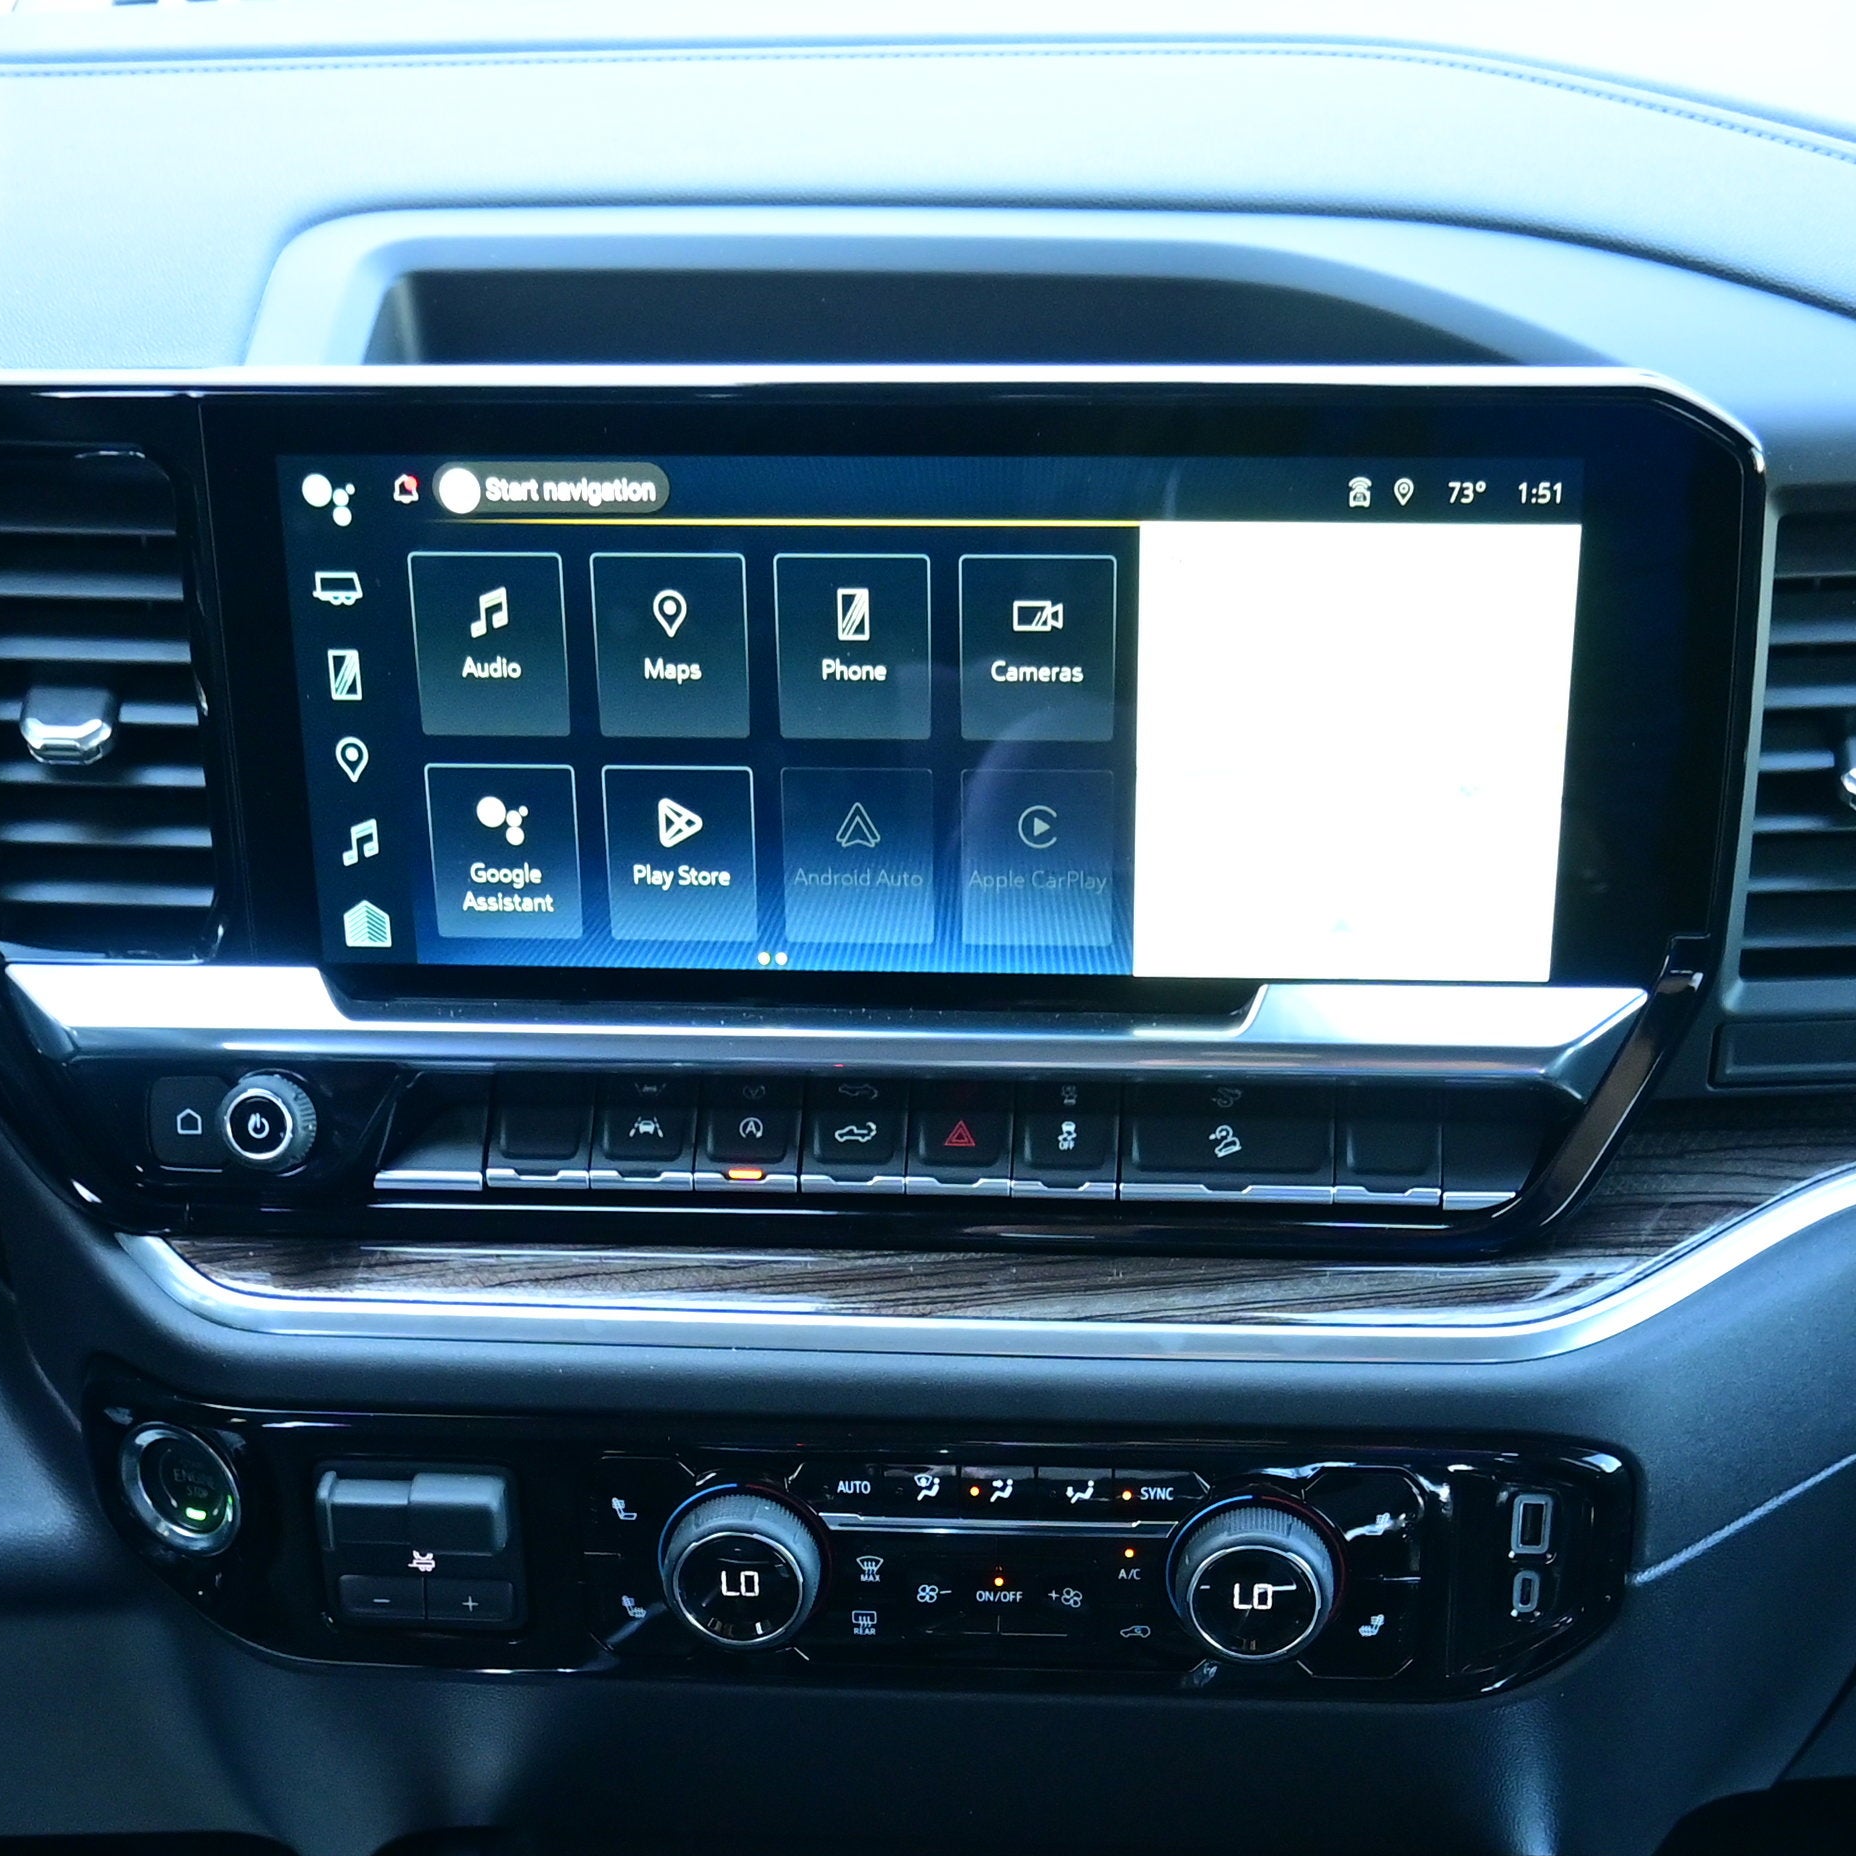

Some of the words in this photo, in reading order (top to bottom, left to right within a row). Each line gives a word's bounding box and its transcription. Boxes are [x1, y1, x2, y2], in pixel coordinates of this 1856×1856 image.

[485, 477, 537, 502] Start
[543, 477, 658, 506] navigation
[1517, 482, 1564, 505] 1:51
[461, 656, 522, 680] Audio
[644, 658, 703, 684] Maps
[821, 658, 888, 682] Phone
[990, 660, 1084, 684] Cameras
[469, 863, 543, 889] Google
[633, 865, 675, 891] Play
[677, 865, 732, 887] Store
[794, 867, 871, 888] Android
[876, 868, 924, 888] Auto
[967, 870, 1026, 892] Apple
[1030, 870, 1108, 893] CarPlay
[462, 890, 555, 914] Assistant
[1057, 1139, 1077, 1151] OFF
[836, 1480, 872, 1495] AUTO
[1140, 1486, 1175, 1502] SYNC
[720, 1569, 760, 1598] LO
[859, 1572, 882, 1583] MAX
[1118, 1566, 1142, 1581] A/C
[976, 1590, 1024, 1604] ON/OFF
[852, 1626, 877, 1636] REAR
